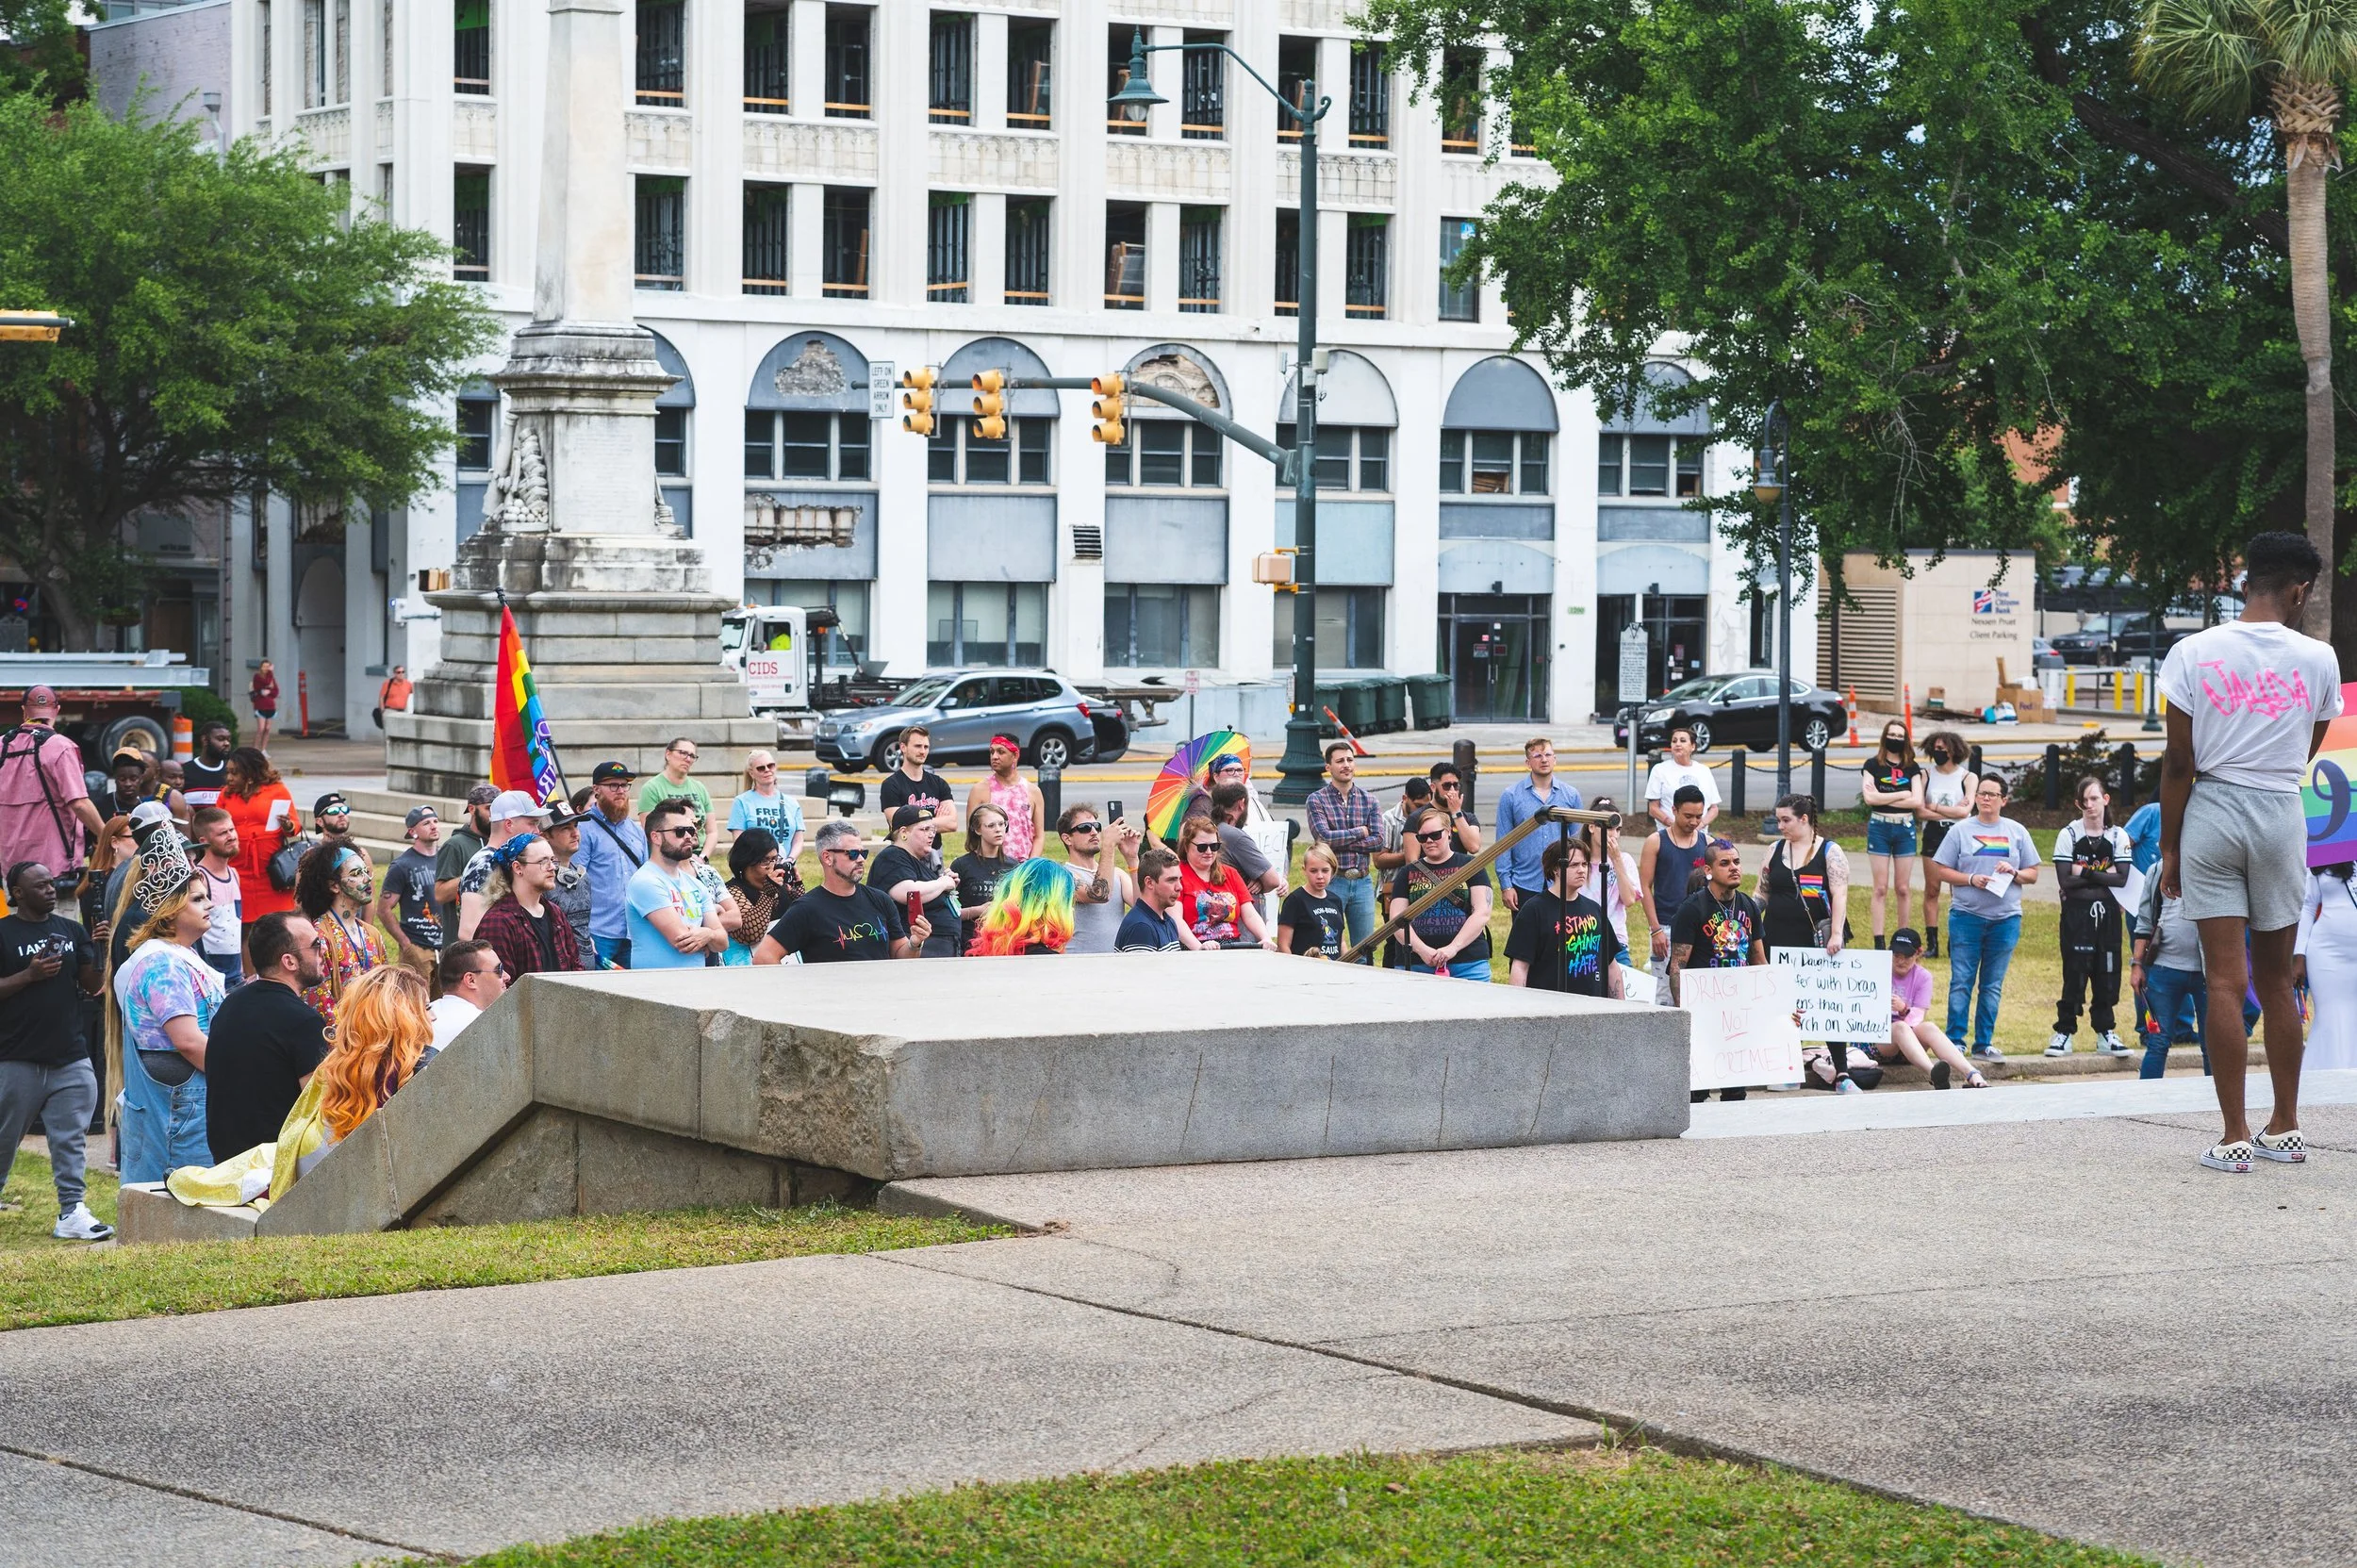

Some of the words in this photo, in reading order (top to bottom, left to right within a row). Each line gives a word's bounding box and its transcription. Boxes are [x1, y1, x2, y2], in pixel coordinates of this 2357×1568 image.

[872, 367, 882, 376] LEFT
[884, 367, 891, 376] ON
[874, 379, 889, 388] GREEN
[874, 391, 889, 400] ARROW
[875, 404, 887, 412] ONLY
[749, 661, 778, 675] CIDS
[755, 807, 786, 817] FRE
[756, 817, 790, 829] MOM
[1702, 911, 1724, 937] DRAG
[1565, 933, 1602, 954] GAINST
[1568, 952, 1598, 978] HATE
[1801, 951, 1844, 971] Daughter
[1685, 973, 1739, 1007] DRAG
[1749, 969, 1777, 1001] IS
[1794, 973, 1812, 988] fer
[1816, 974, 1842, 992] with
[1847, 977, 1878, 999] Drag
[1819, 998, 1843, 1014] than
[1721, 1006, 1753, 1034] NOT
[1824, 1018, 1840, 1032] on
